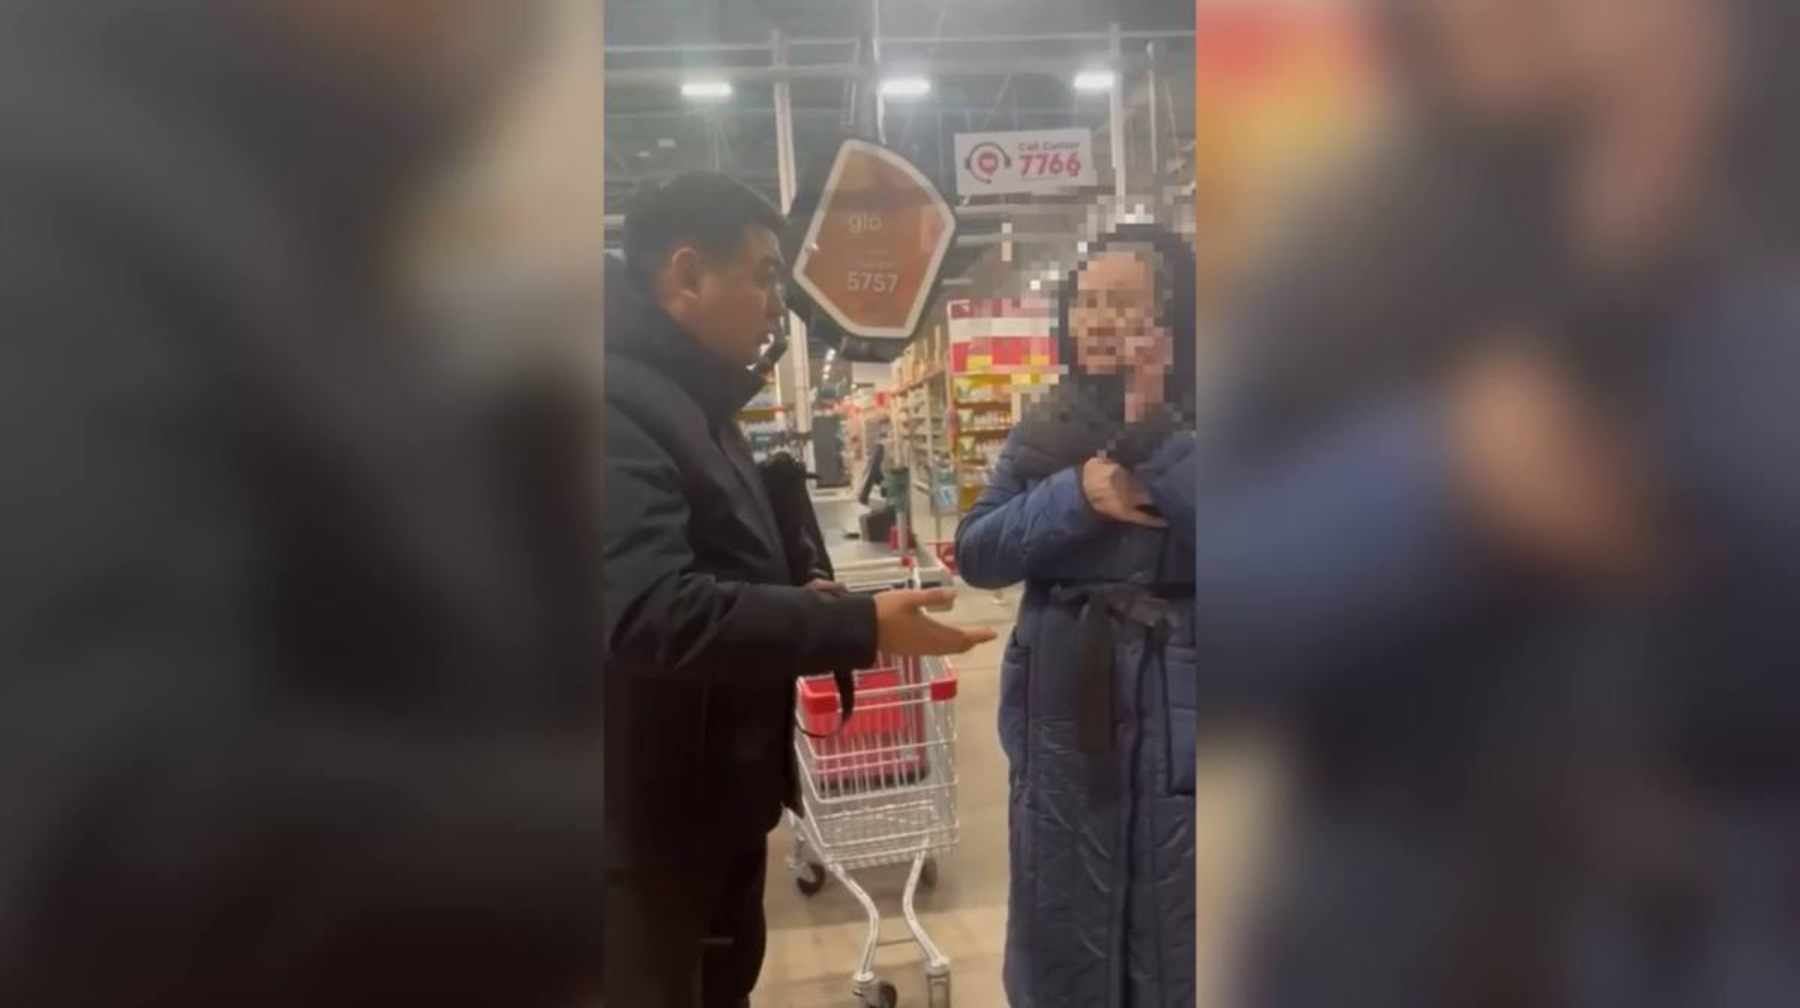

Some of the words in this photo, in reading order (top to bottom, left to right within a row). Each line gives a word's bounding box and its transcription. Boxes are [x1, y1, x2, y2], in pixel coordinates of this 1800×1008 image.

[1018, 142, 1039, 151] Call
[1018, 152, 1081, 177] 7766
[847, 272, 899, 293] 5757
